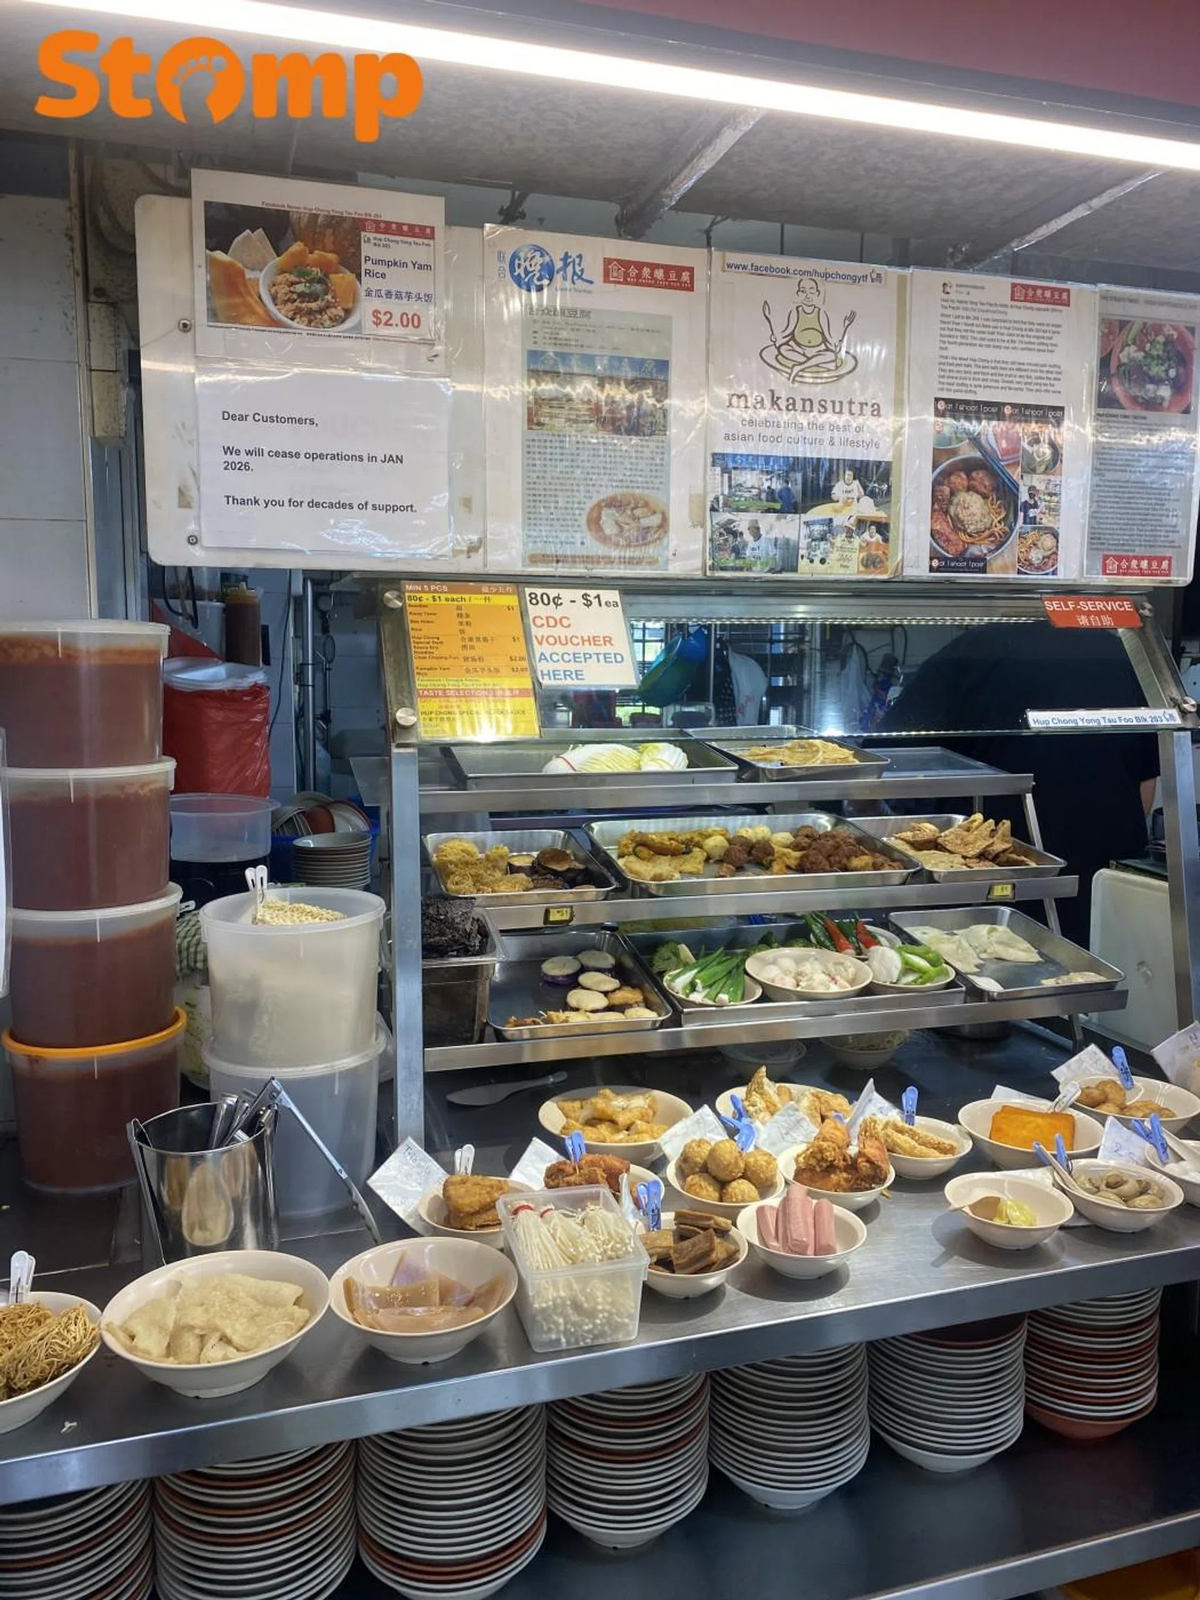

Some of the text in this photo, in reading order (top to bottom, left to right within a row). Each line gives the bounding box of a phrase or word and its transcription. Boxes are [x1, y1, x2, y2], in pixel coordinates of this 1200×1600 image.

[364, 255, 432, 272] Pumpkin Yam
[364, 268, 387, 279] Rice
[726, 261, 869, 284] www.facebook.com/hupchongytf
[371, 309, 422, 329] $2.00
[726, 389, 881, 418] makansutra
[222, 411, 319, 428] Dear Customers,
[741, 418, 865, 434] celebrating the best of
[724, 432, 880, 450] asian food culture & lifestyle
[223, 446, 404, 464] We will cease operations in JAN
[223, 461, 254, 473] 2026.
[224, 495, 418, 514] Thank you for decades of support.
[430, 584, 448, 592] PCS
[528, 592, 563, 609] 80¢
[1043, 600, 1134, 612] SELF-SERVICE
[531, 615, 571, 628] CDC
[1077, 615, 1114, 626] 请自助
[534, 635, 614, 646] VOUCHER
[537, 652, 624, 664] ACCEPTED
[540, 669, 585, 681] HERE
[1033, 718, 1050, 727] Hup
[1051, 717, 1079, 726] Chong
[1080, 716, 1101, 726] Yong
[1101, 716, 1118, 724] Tau
[1118, 716, 1134, 724] Foo
[1134, 715, 1149, 724] Blk
